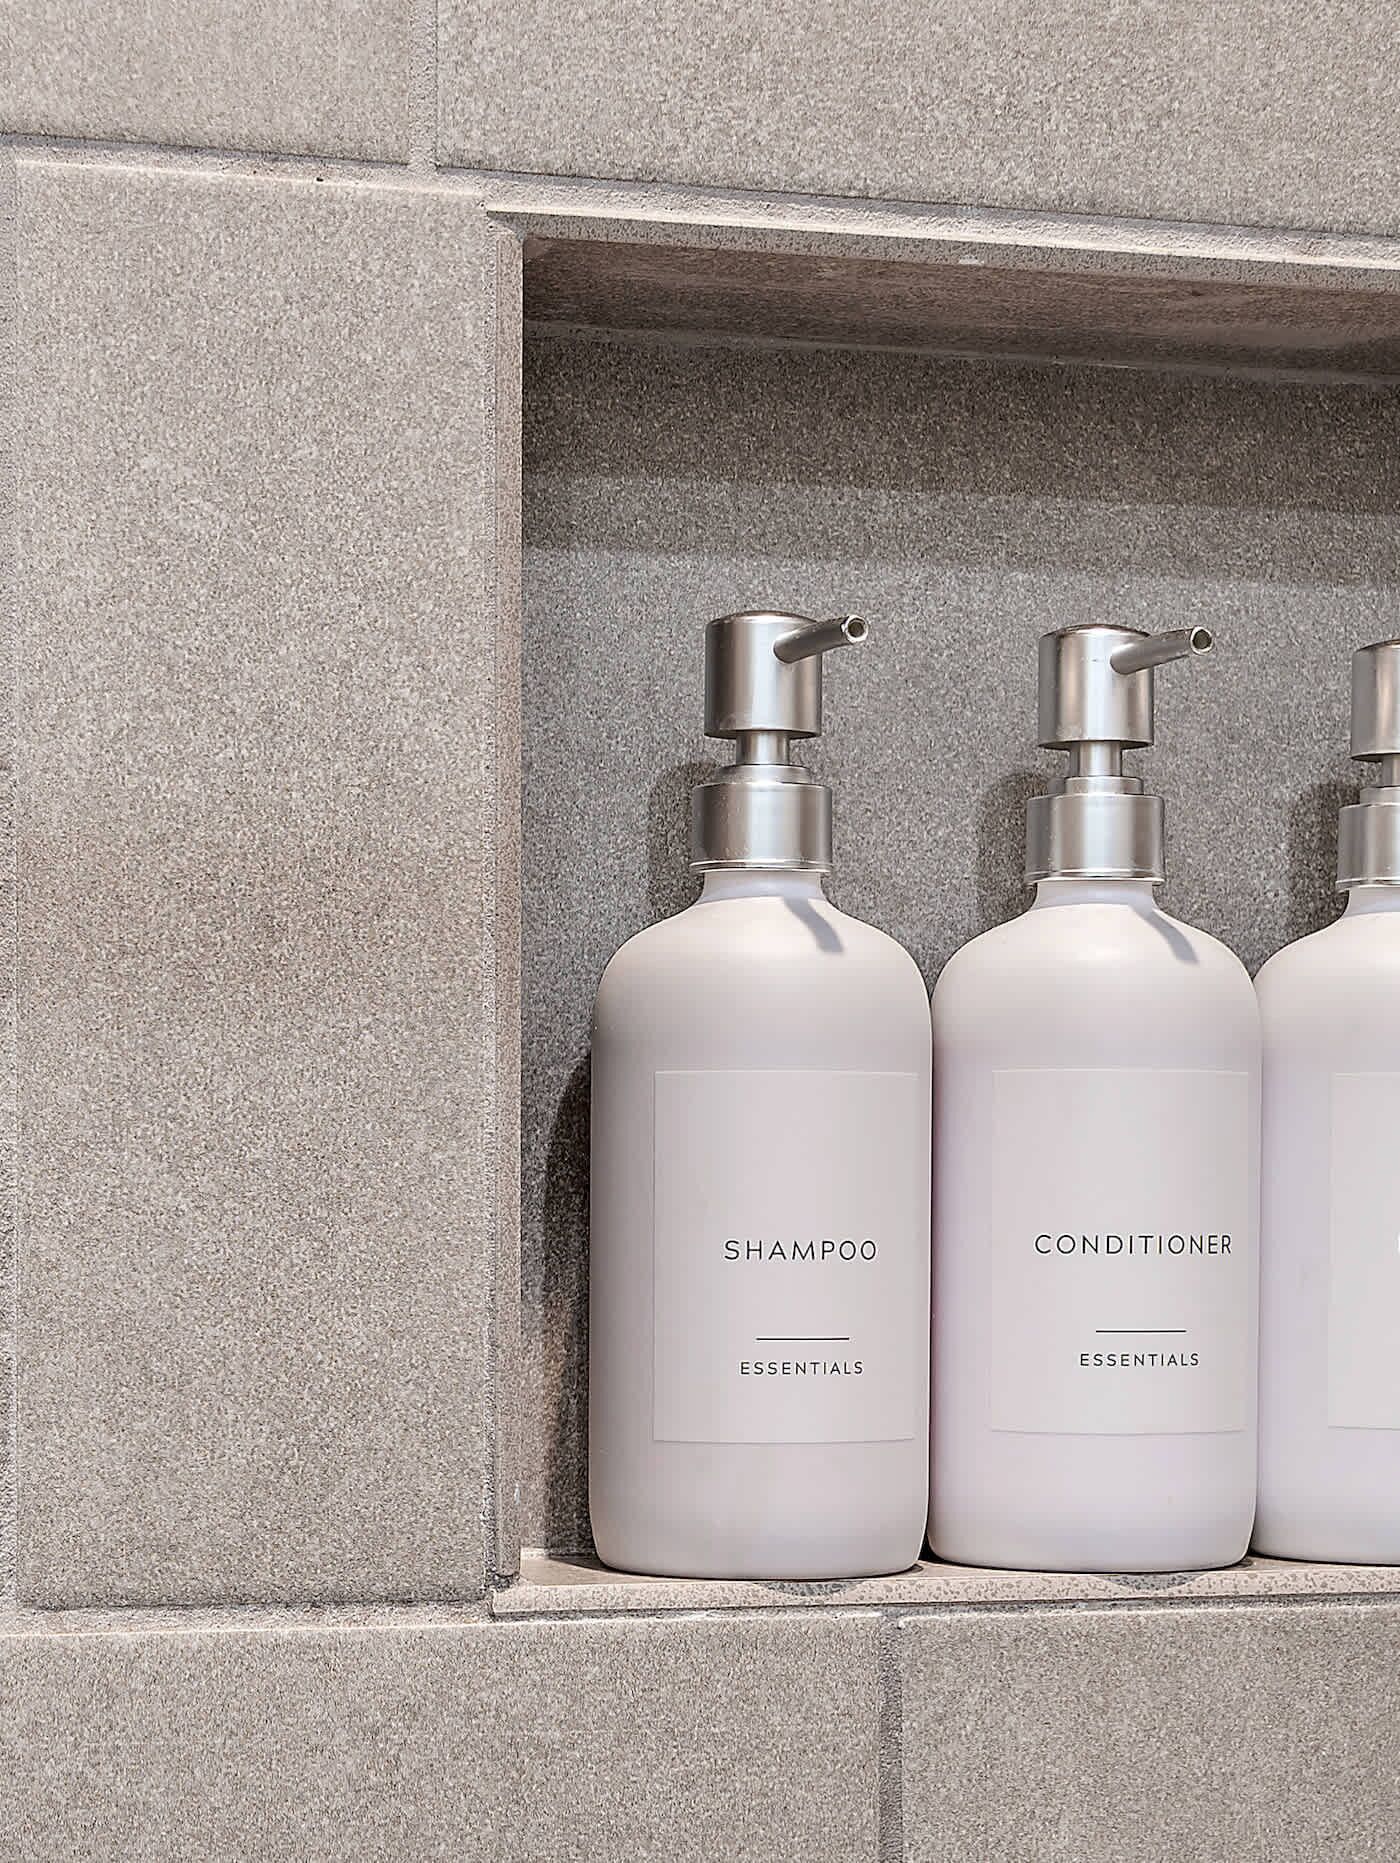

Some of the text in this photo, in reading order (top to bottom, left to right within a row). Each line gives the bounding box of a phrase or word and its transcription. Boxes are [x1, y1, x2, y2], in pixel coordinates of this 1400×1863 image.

[724, 1239, 877, 1261] SHAMPOO
[1034, 1233, 1232, 1255] CONDITIONER
[740, 1361, 864, 1376] ESSENTIALS
[1079, 1352, 1200, 1367] ESSENTIALS
